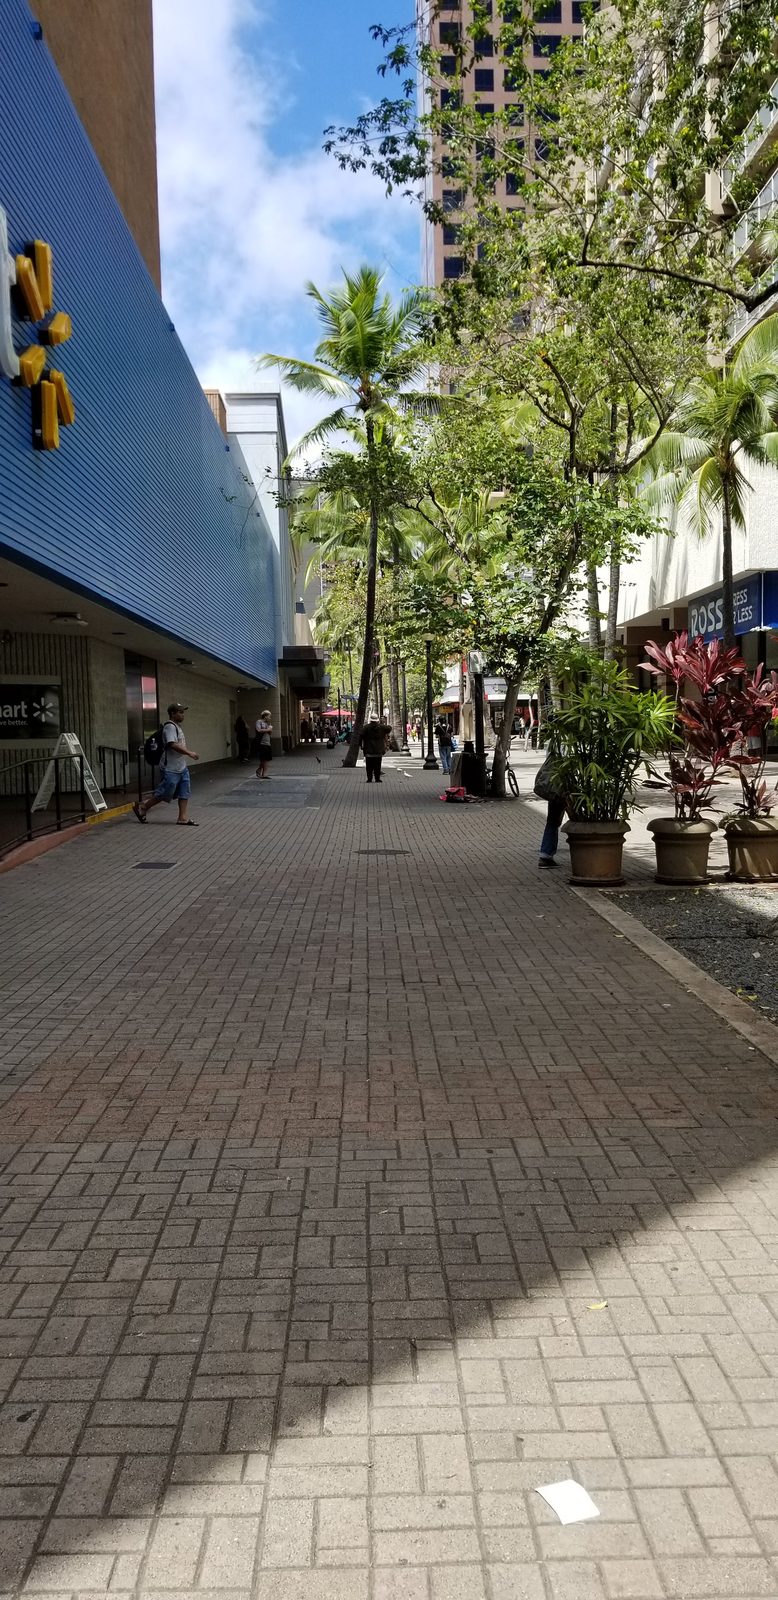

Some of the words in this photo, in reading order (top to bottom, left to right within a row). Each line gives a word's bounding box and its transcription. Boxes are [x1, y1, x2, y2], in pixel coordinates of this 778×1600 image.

[732, 588, 748, 607] RESS
[691, 598, 724, 638] ROSS
[737, 605, 753, 623] LESS
[0, 701, 28, 718] art
